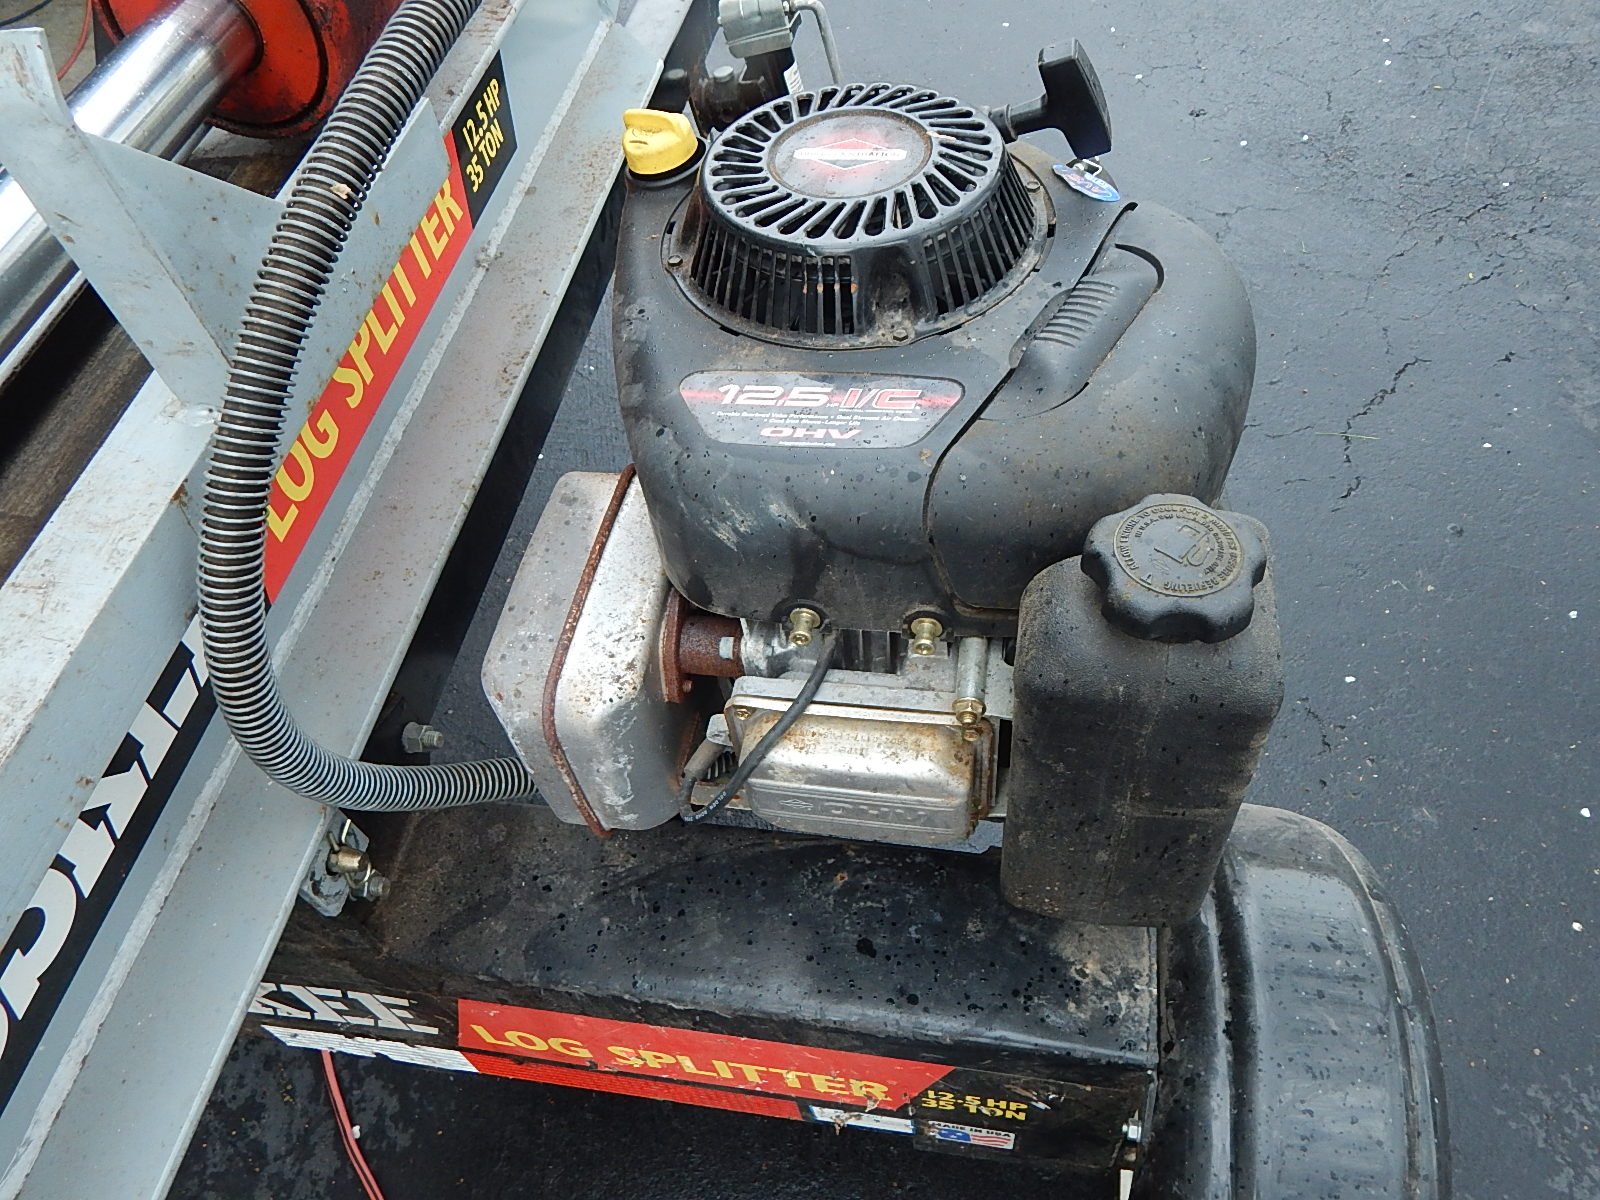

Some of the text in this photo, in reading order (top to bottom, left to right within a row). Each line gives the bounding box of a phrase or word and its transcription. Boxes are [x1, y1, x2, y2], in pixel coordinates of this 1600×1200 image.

[463, 78, 500, 153] 12.5 HP
[466, 118, 504, 193] 35 TON
[759, 426, 863, 440] OHV
[264, 408, 341, 544] LOG
[471, 1023, 892, 1101] LOG SPLITTER
[921, 1097, 1026, 1121] 35 TON
[928, 1090, 1028, 1111] 12.5 HP
[986, 1130, 1012, 1138] USA
